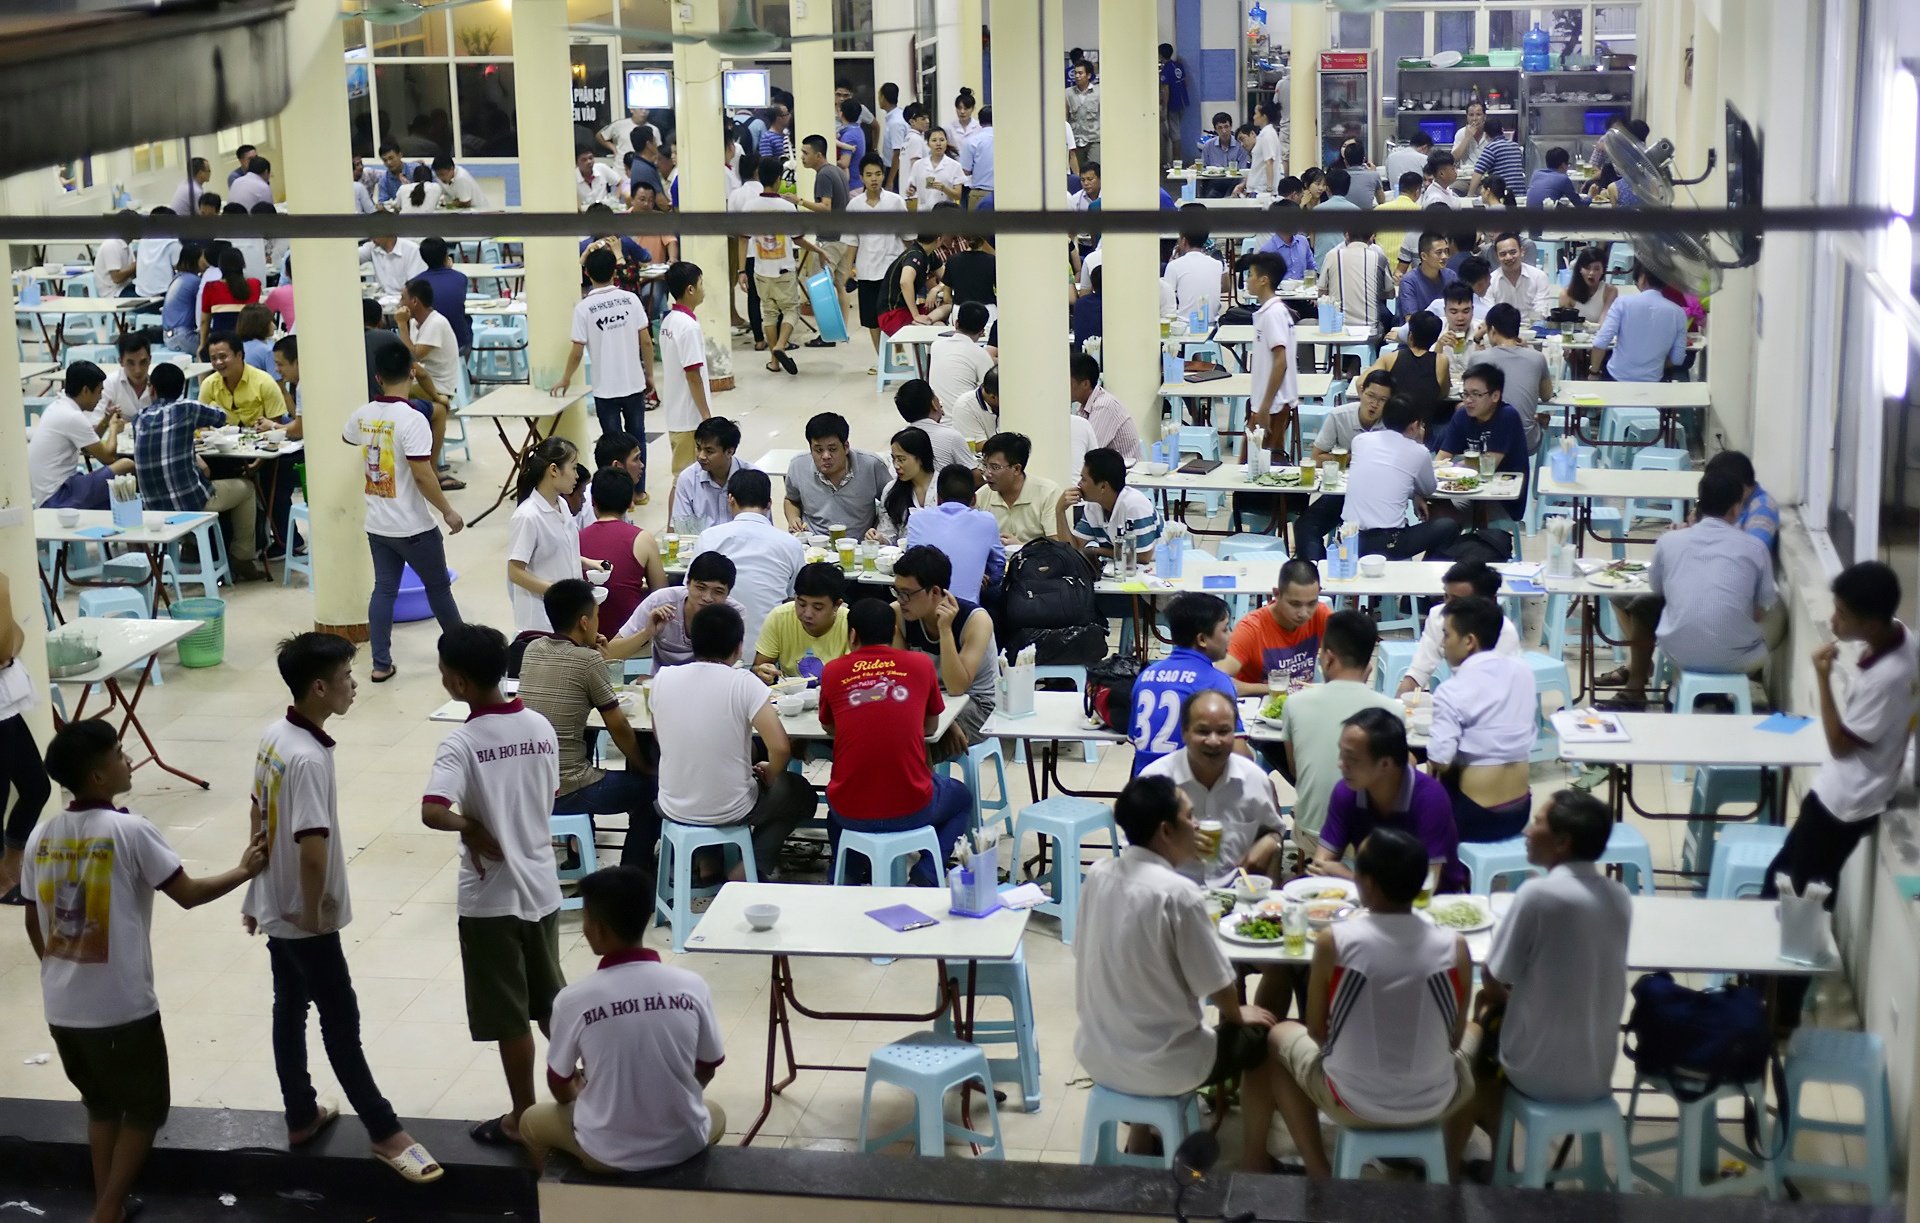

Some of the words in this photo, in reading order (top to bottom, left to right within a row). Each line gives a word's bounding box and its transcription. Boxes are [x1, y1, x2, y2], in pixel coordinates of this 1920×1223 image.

[582, 105, 596, 121] VÀO
[852, 659, 896, 673] Riders
[1278, 651, 1308, 669] UTILITY
[1156, 670, 1180, 682] SAO
[1179, 671, 1197, 684] FC
[1134, 689, 1180, 752] 32
[476, 749, 496, 764] BIA
[520, 739, 535, 756] HÀ
[583, 1006, 608, 1026] BIA
[610, 999, 640, 1017] HƠI
[643, 993, 666, 1011] HÀ
